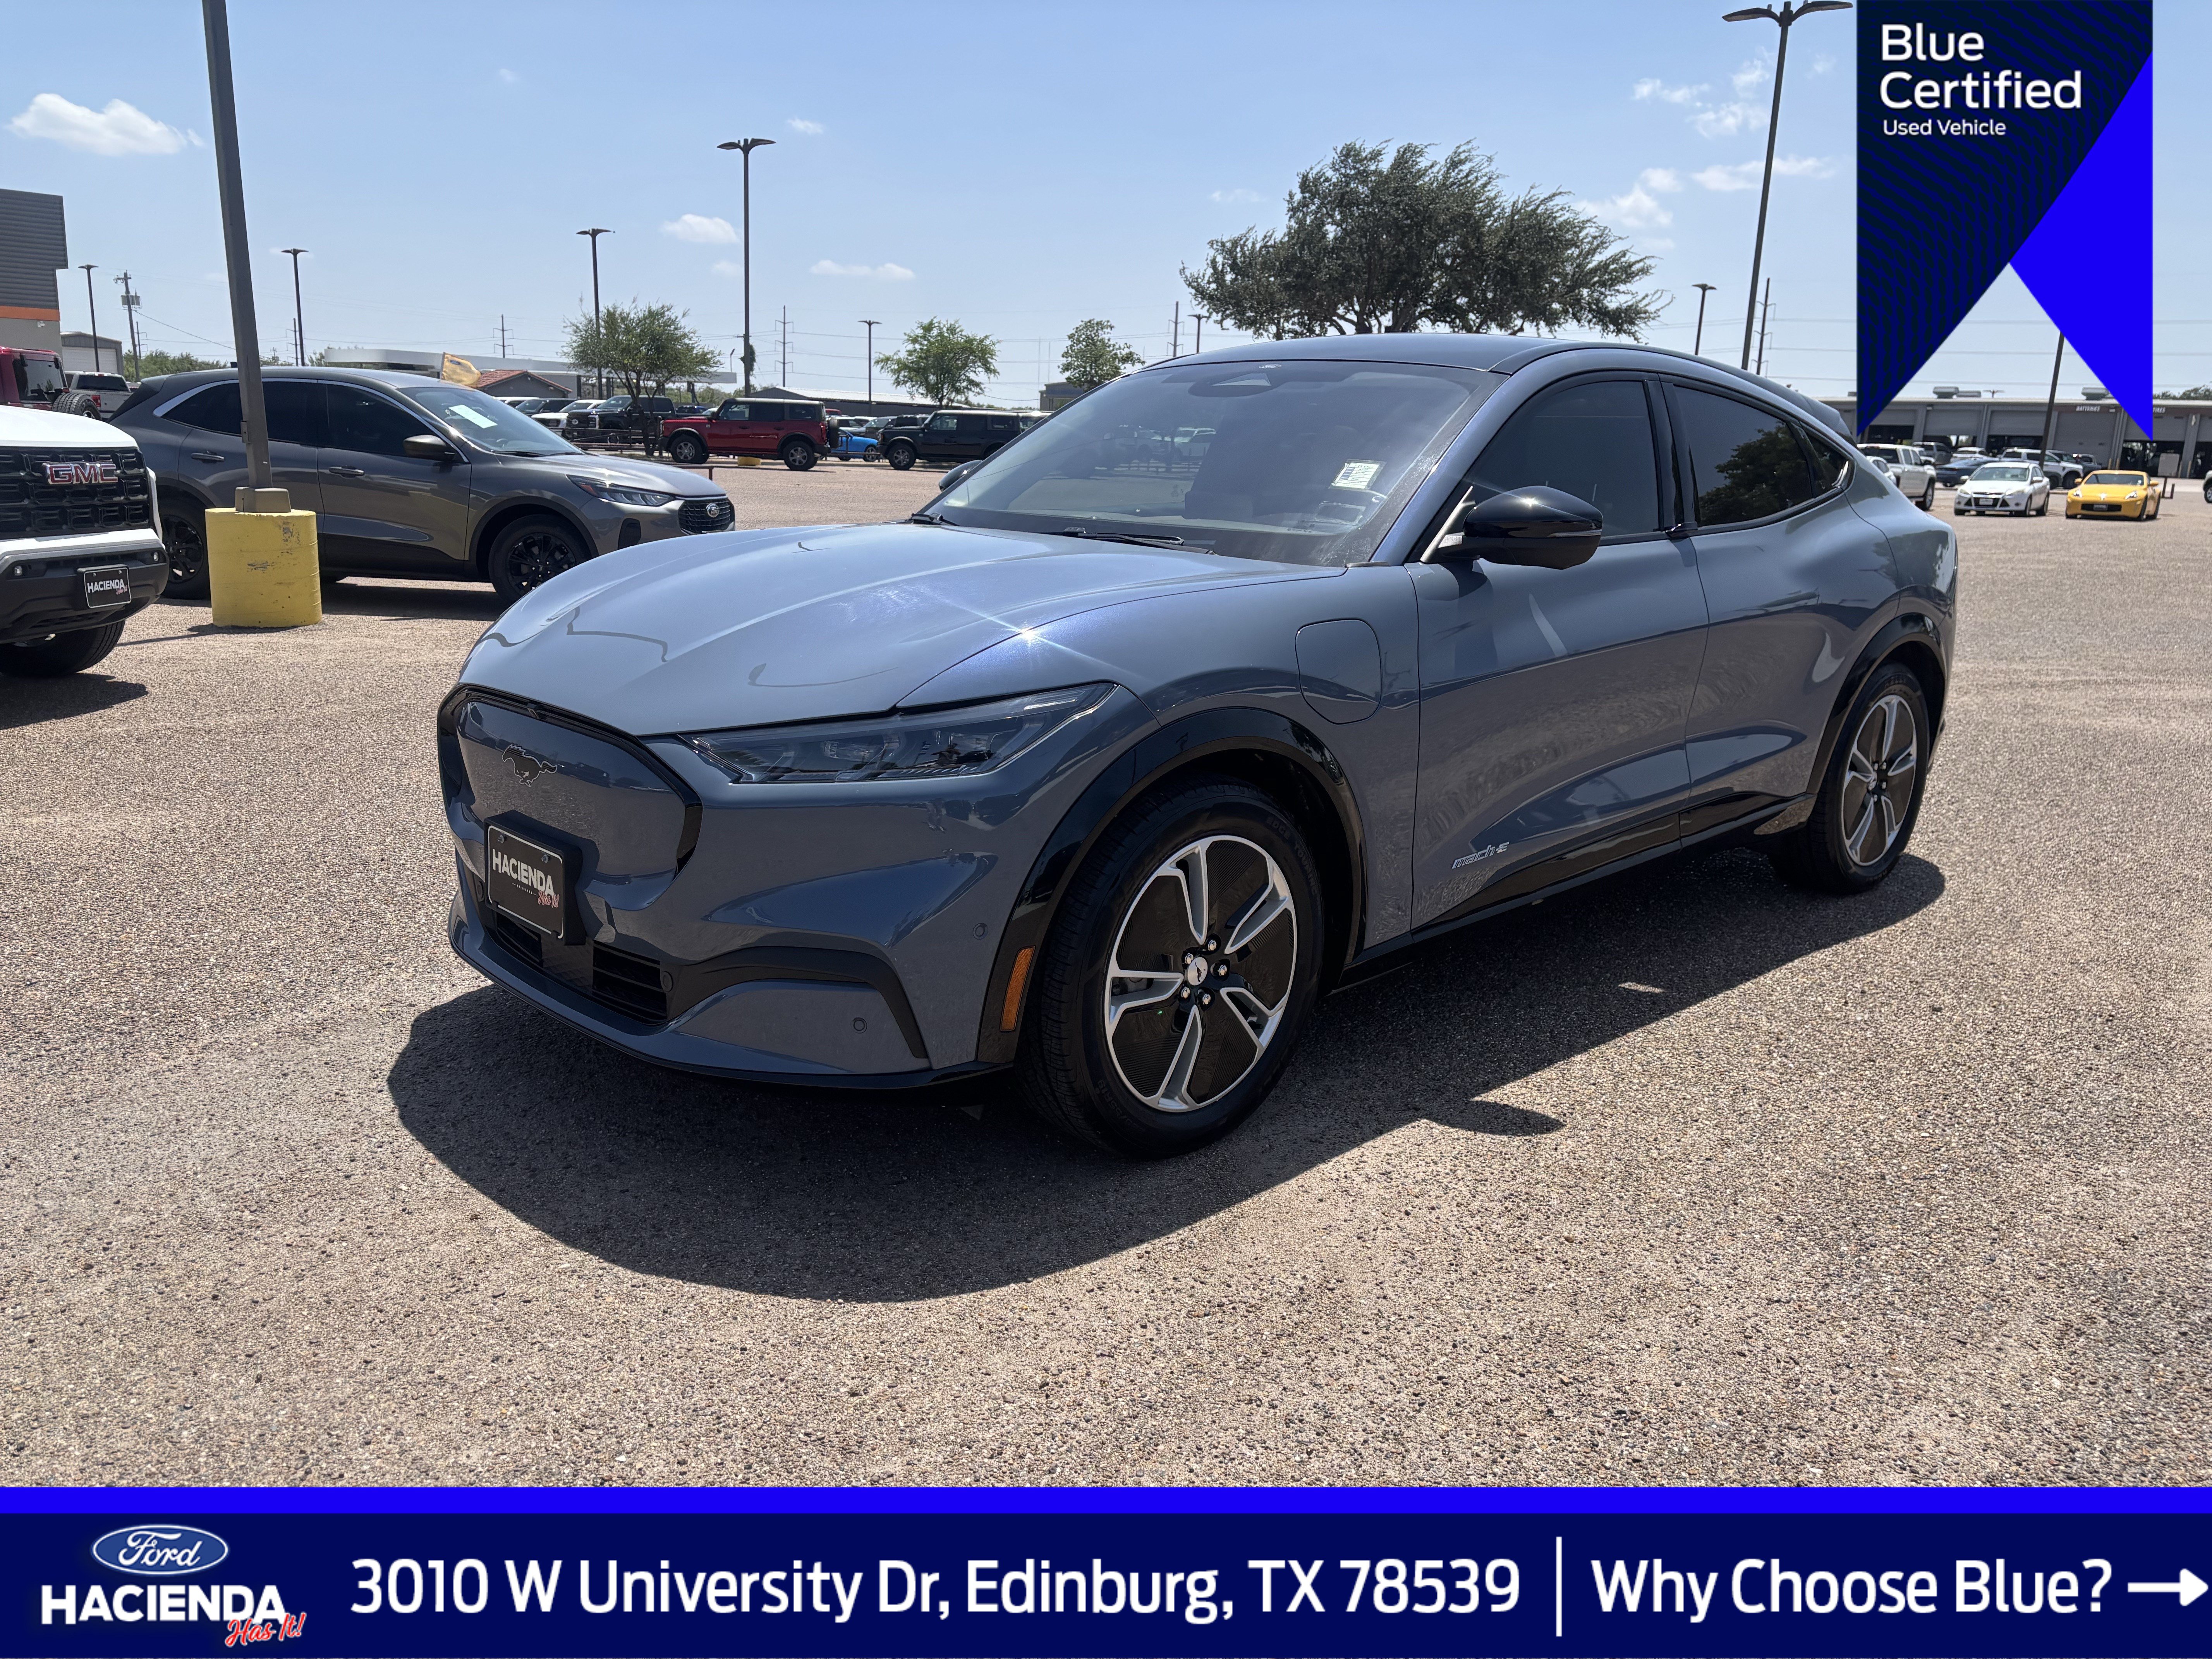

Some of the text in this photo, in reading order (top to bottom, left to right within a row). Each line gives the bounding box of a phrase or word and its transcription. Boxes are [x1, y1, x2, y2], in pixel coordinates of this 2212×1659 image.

[46, 464, 118, 484] GMC
[87, 579, 125, 593] HACIENDA
[492, 848, 555, 898] HACIENDA
